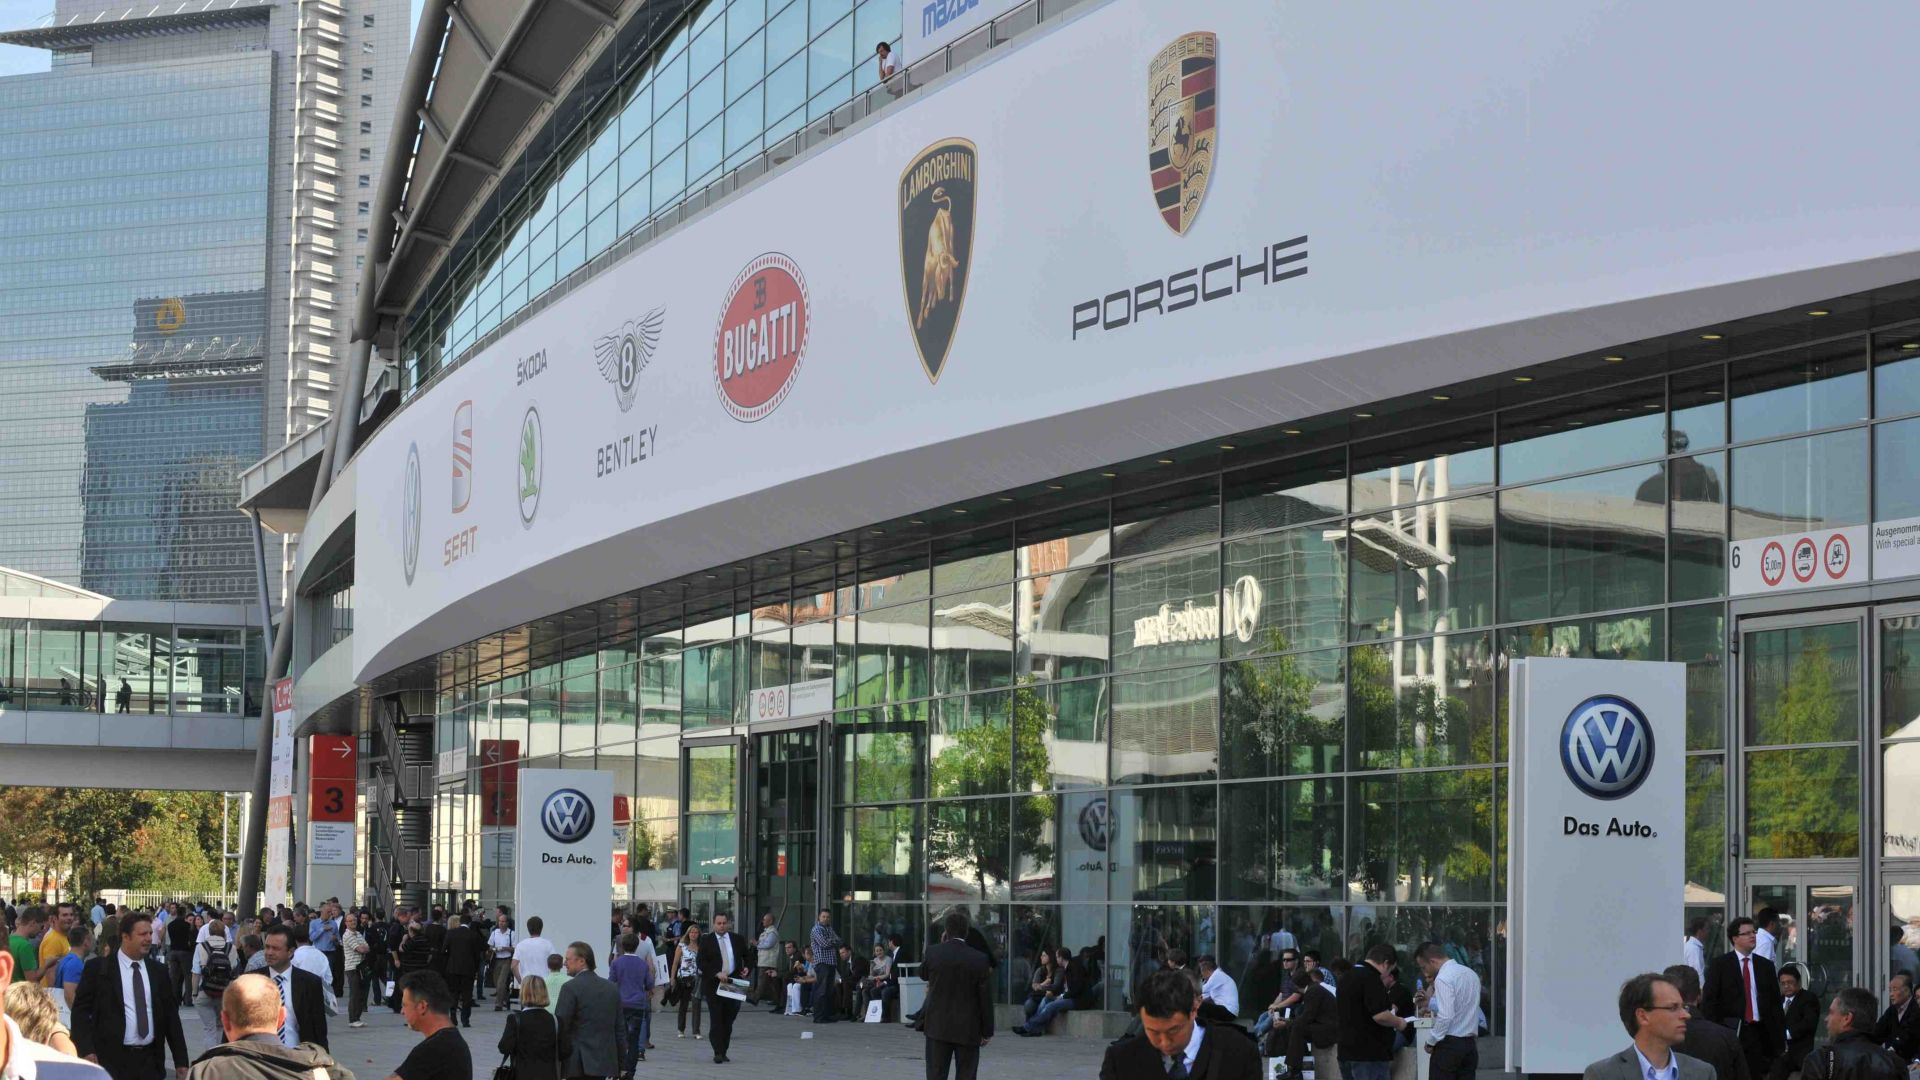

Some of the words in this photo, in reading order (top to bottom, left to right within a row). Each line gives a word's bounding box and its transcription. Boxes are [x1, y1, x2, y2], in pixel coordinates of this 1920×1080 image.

[903, 151, 971, 210] LAMBORGHINI
[1072, 234, 1308, 341] PORSCHE
[723, 301, 798, 381] BUGATTI
[516, 348, 548, 387] ŠKODA
[597, 424, 658, 478] BENTLEY
[443, 525, 478, 567] SEAT
[1731, 545, 1741, 569] 6
[1876, 539, 1891, 550] With
[1893, 535, 1915, 550] special
[324, 786, 344, 814] 3
[1563, 816, 1600, 836] Das
[542, 852, 563, 863] Das
